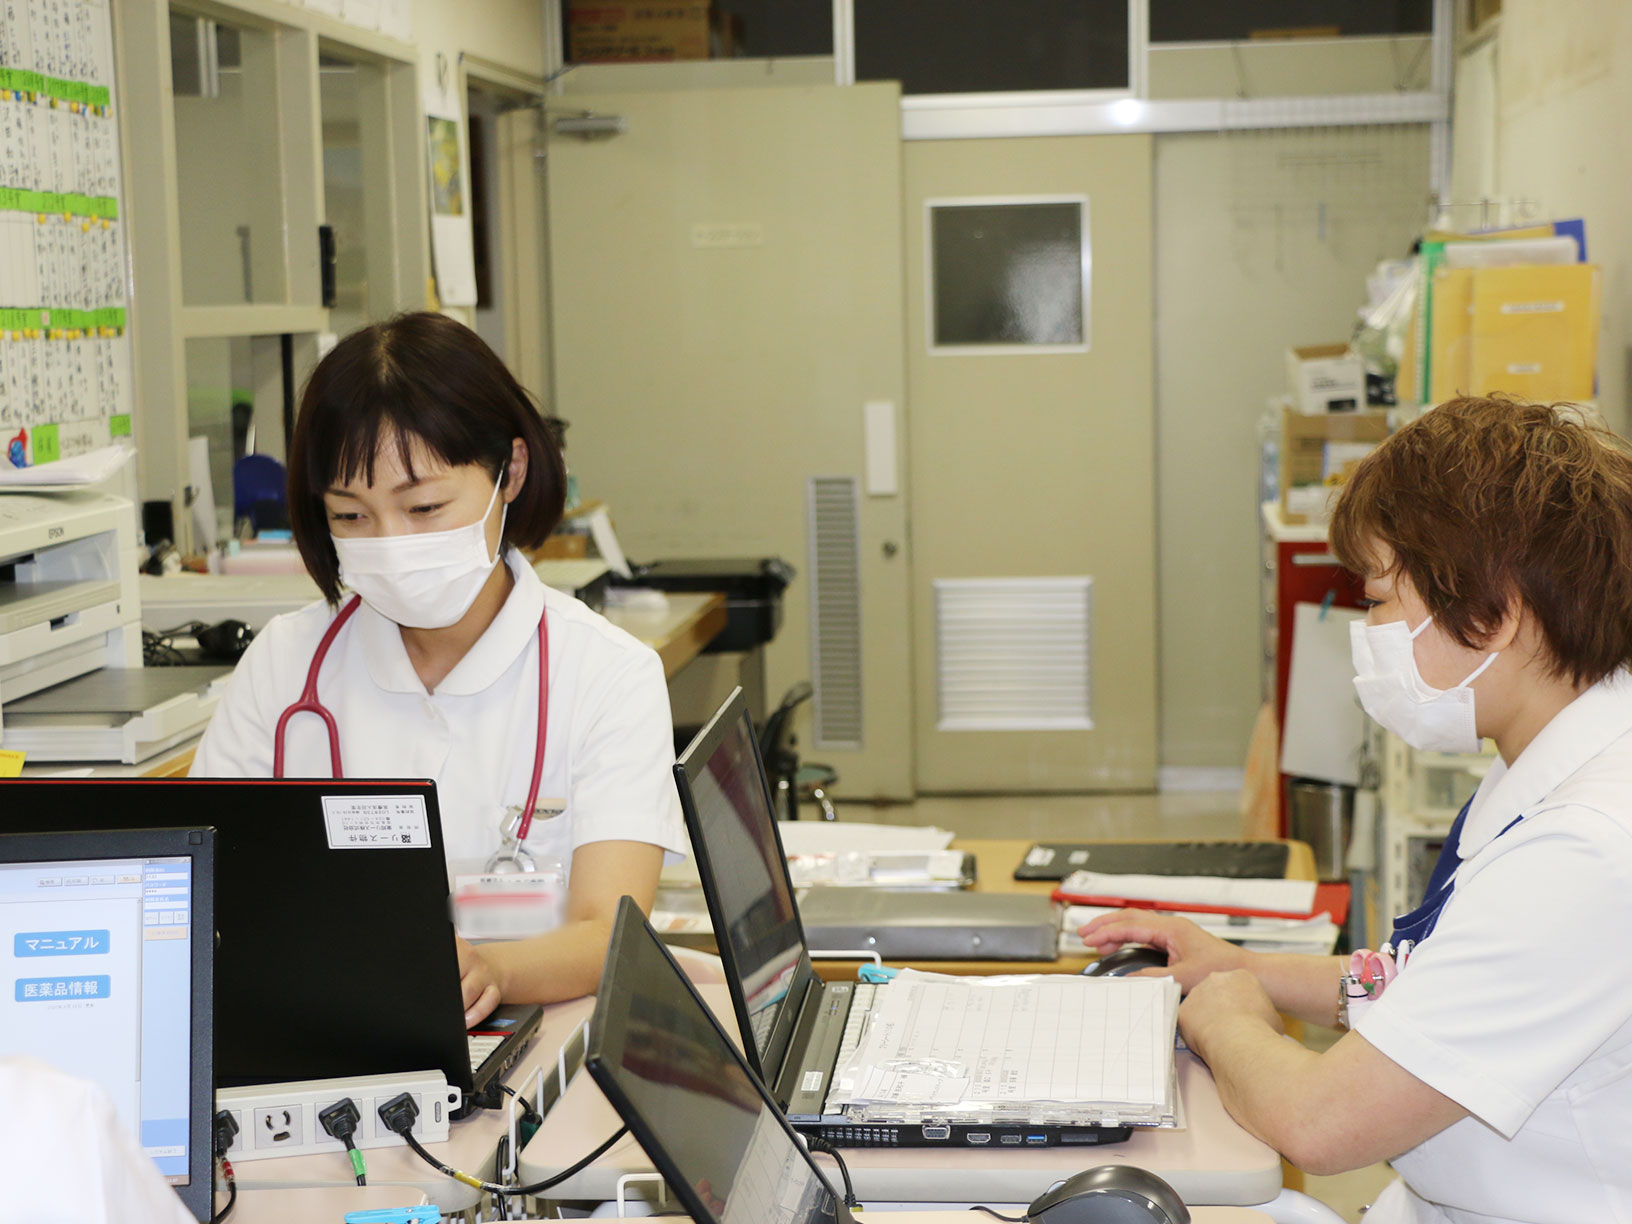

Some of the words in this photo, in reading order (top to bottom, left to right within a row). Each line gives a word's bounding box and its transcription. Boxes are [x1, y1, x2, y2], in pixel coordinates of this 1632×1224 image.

[348, 834, 398, 842] リース物件
[25, 936, 99, 951] マニュアル
[24, 981, 98, 997] 医薬品情報
